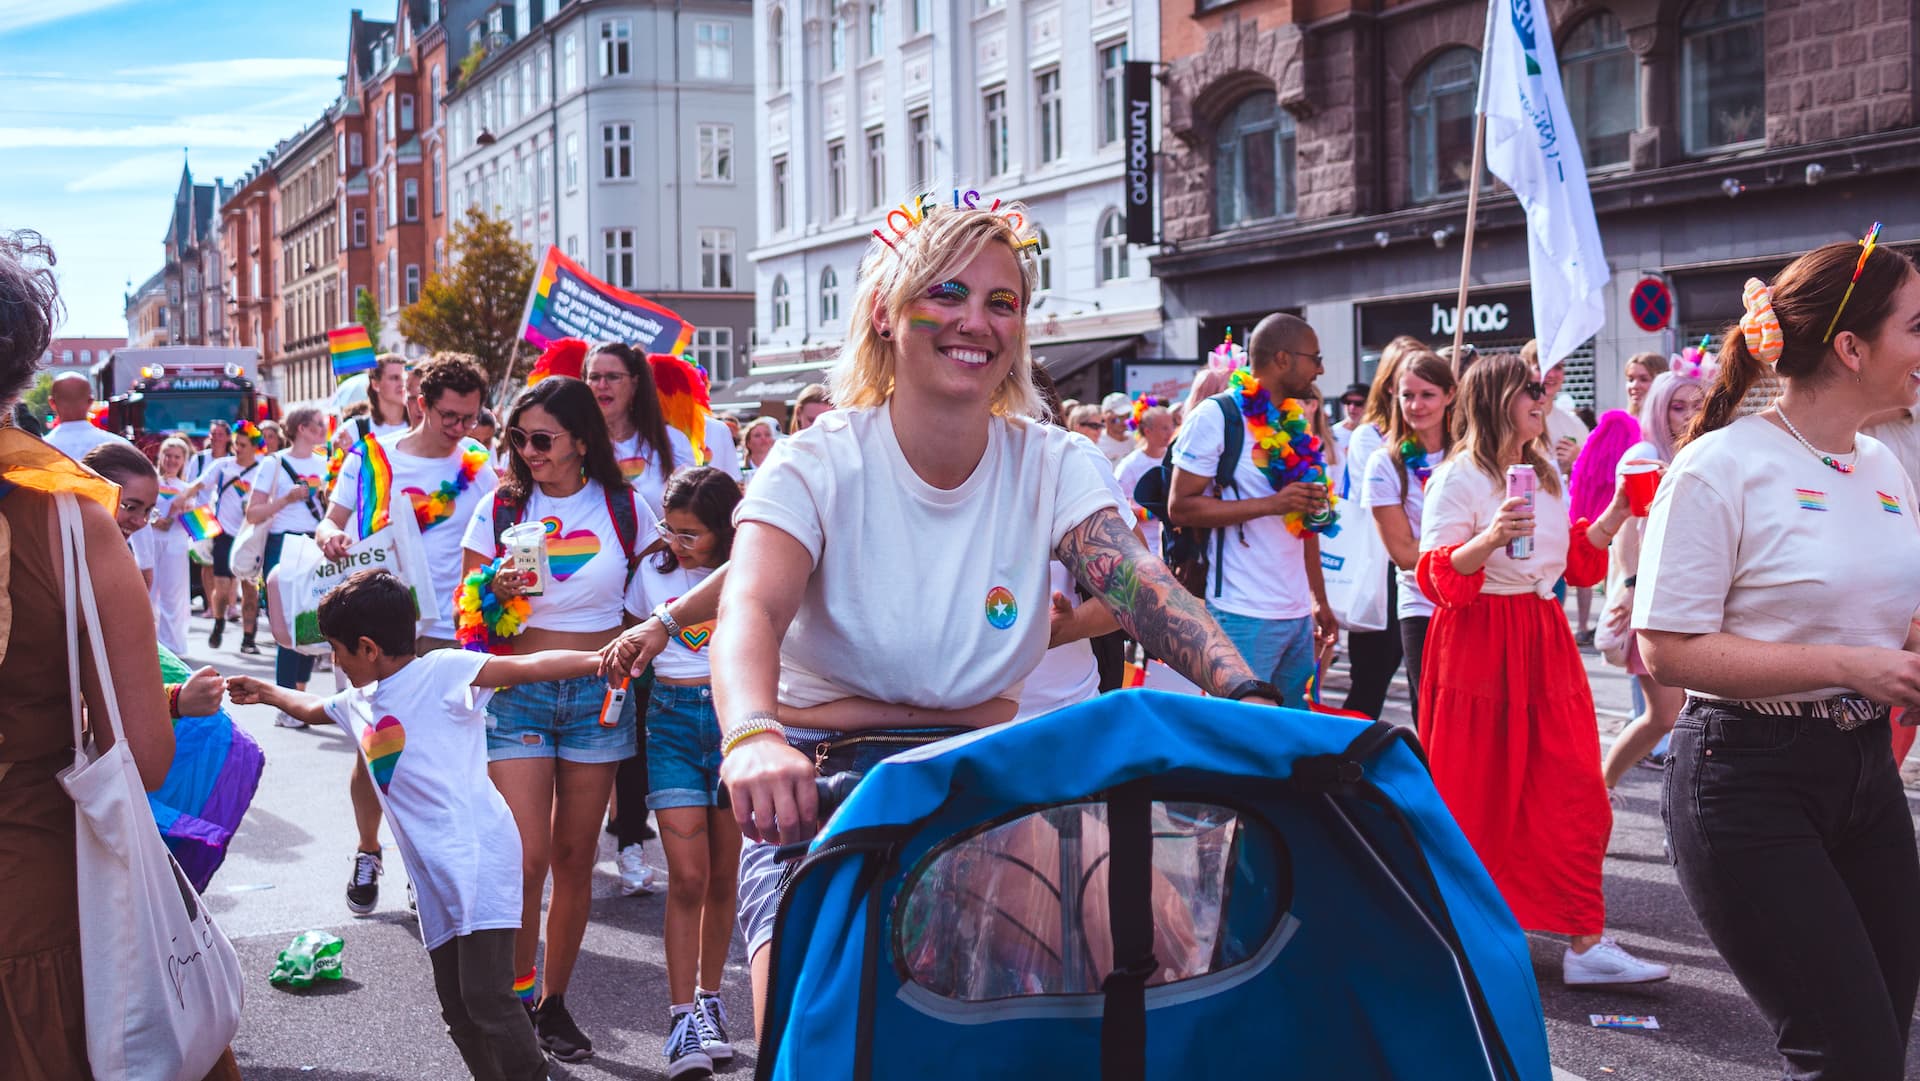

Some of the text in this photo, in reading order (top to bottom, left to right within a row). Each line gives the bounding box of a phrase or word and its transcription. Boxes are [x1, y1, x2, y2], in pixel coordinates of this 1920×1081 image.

[553, 301, 570, 318] full
[569, 311, 590, 330] self
[588, 320, 600, 334] to
[556, 291, 656, 345] so you can bring your
[560, 276, 664, 337] We embrace diversity
[1431, 302, 1509, 335] humac
[557, 319, 585, 340] every
[173, 379, 220, 390] ALMIND
